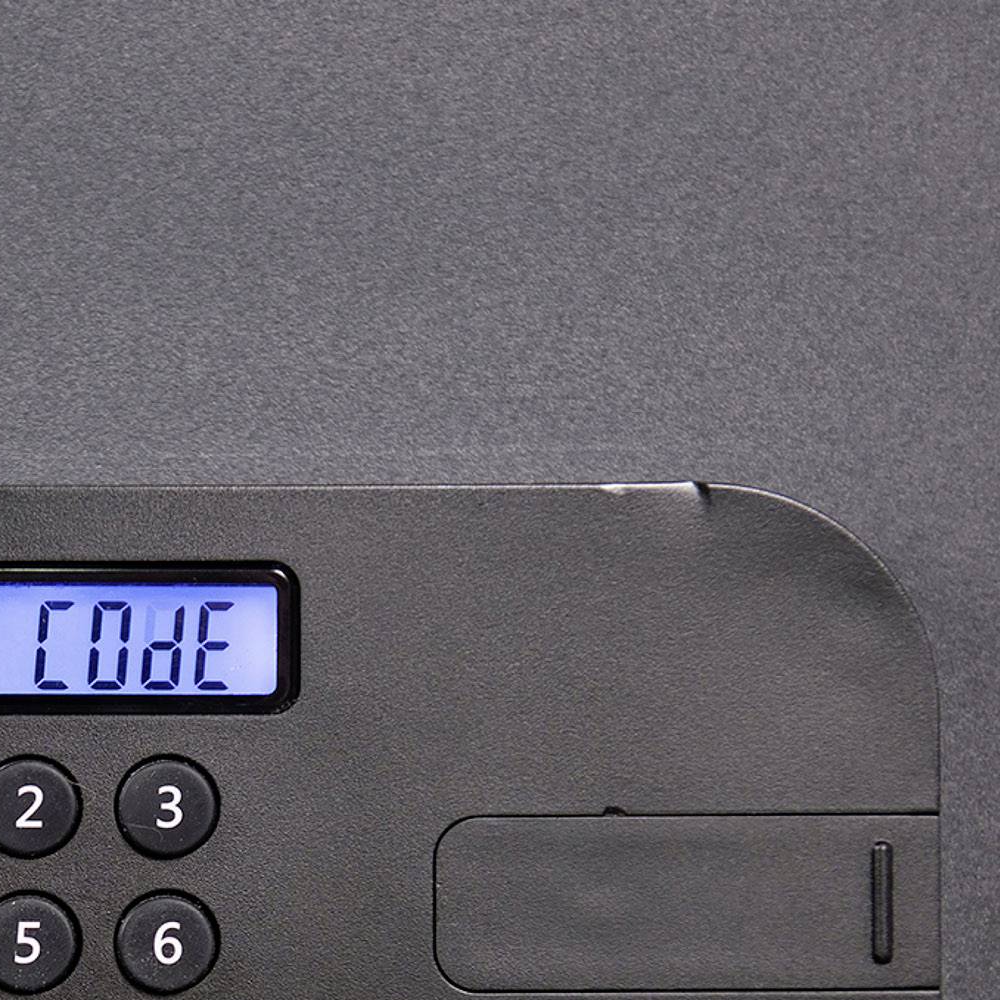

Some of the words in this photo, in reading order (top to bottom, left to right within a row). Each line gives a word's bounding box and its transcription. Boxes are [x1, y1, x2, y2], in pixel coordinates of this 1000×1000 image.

[15, 784, 44, 828] 2
[156, 785, 183, 829] 3
[14, 921, 41, 964] 5
[153, 921, 183, 965] 6
